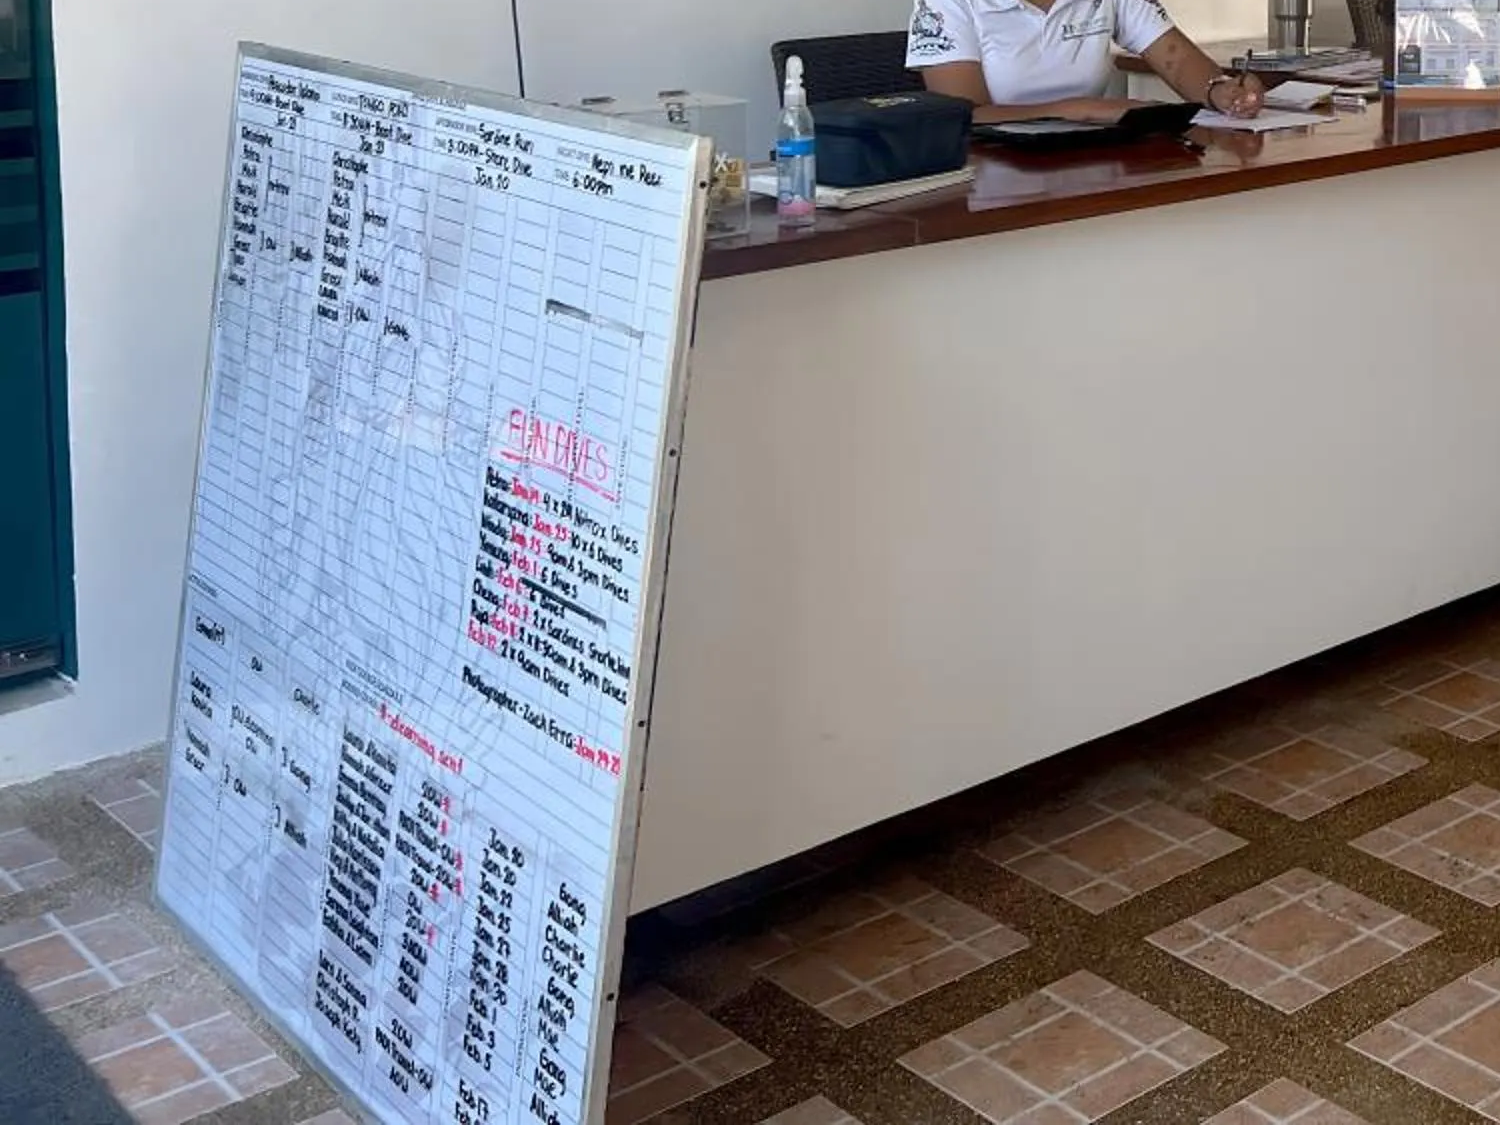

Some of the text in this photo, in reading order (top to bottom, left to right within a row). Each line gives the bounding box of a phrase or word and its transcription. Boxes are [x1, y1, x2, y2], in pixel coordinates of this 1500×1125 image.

[512, 156, 532, 178] Dive
[509, 408, 608, 483] FUN DIVES
